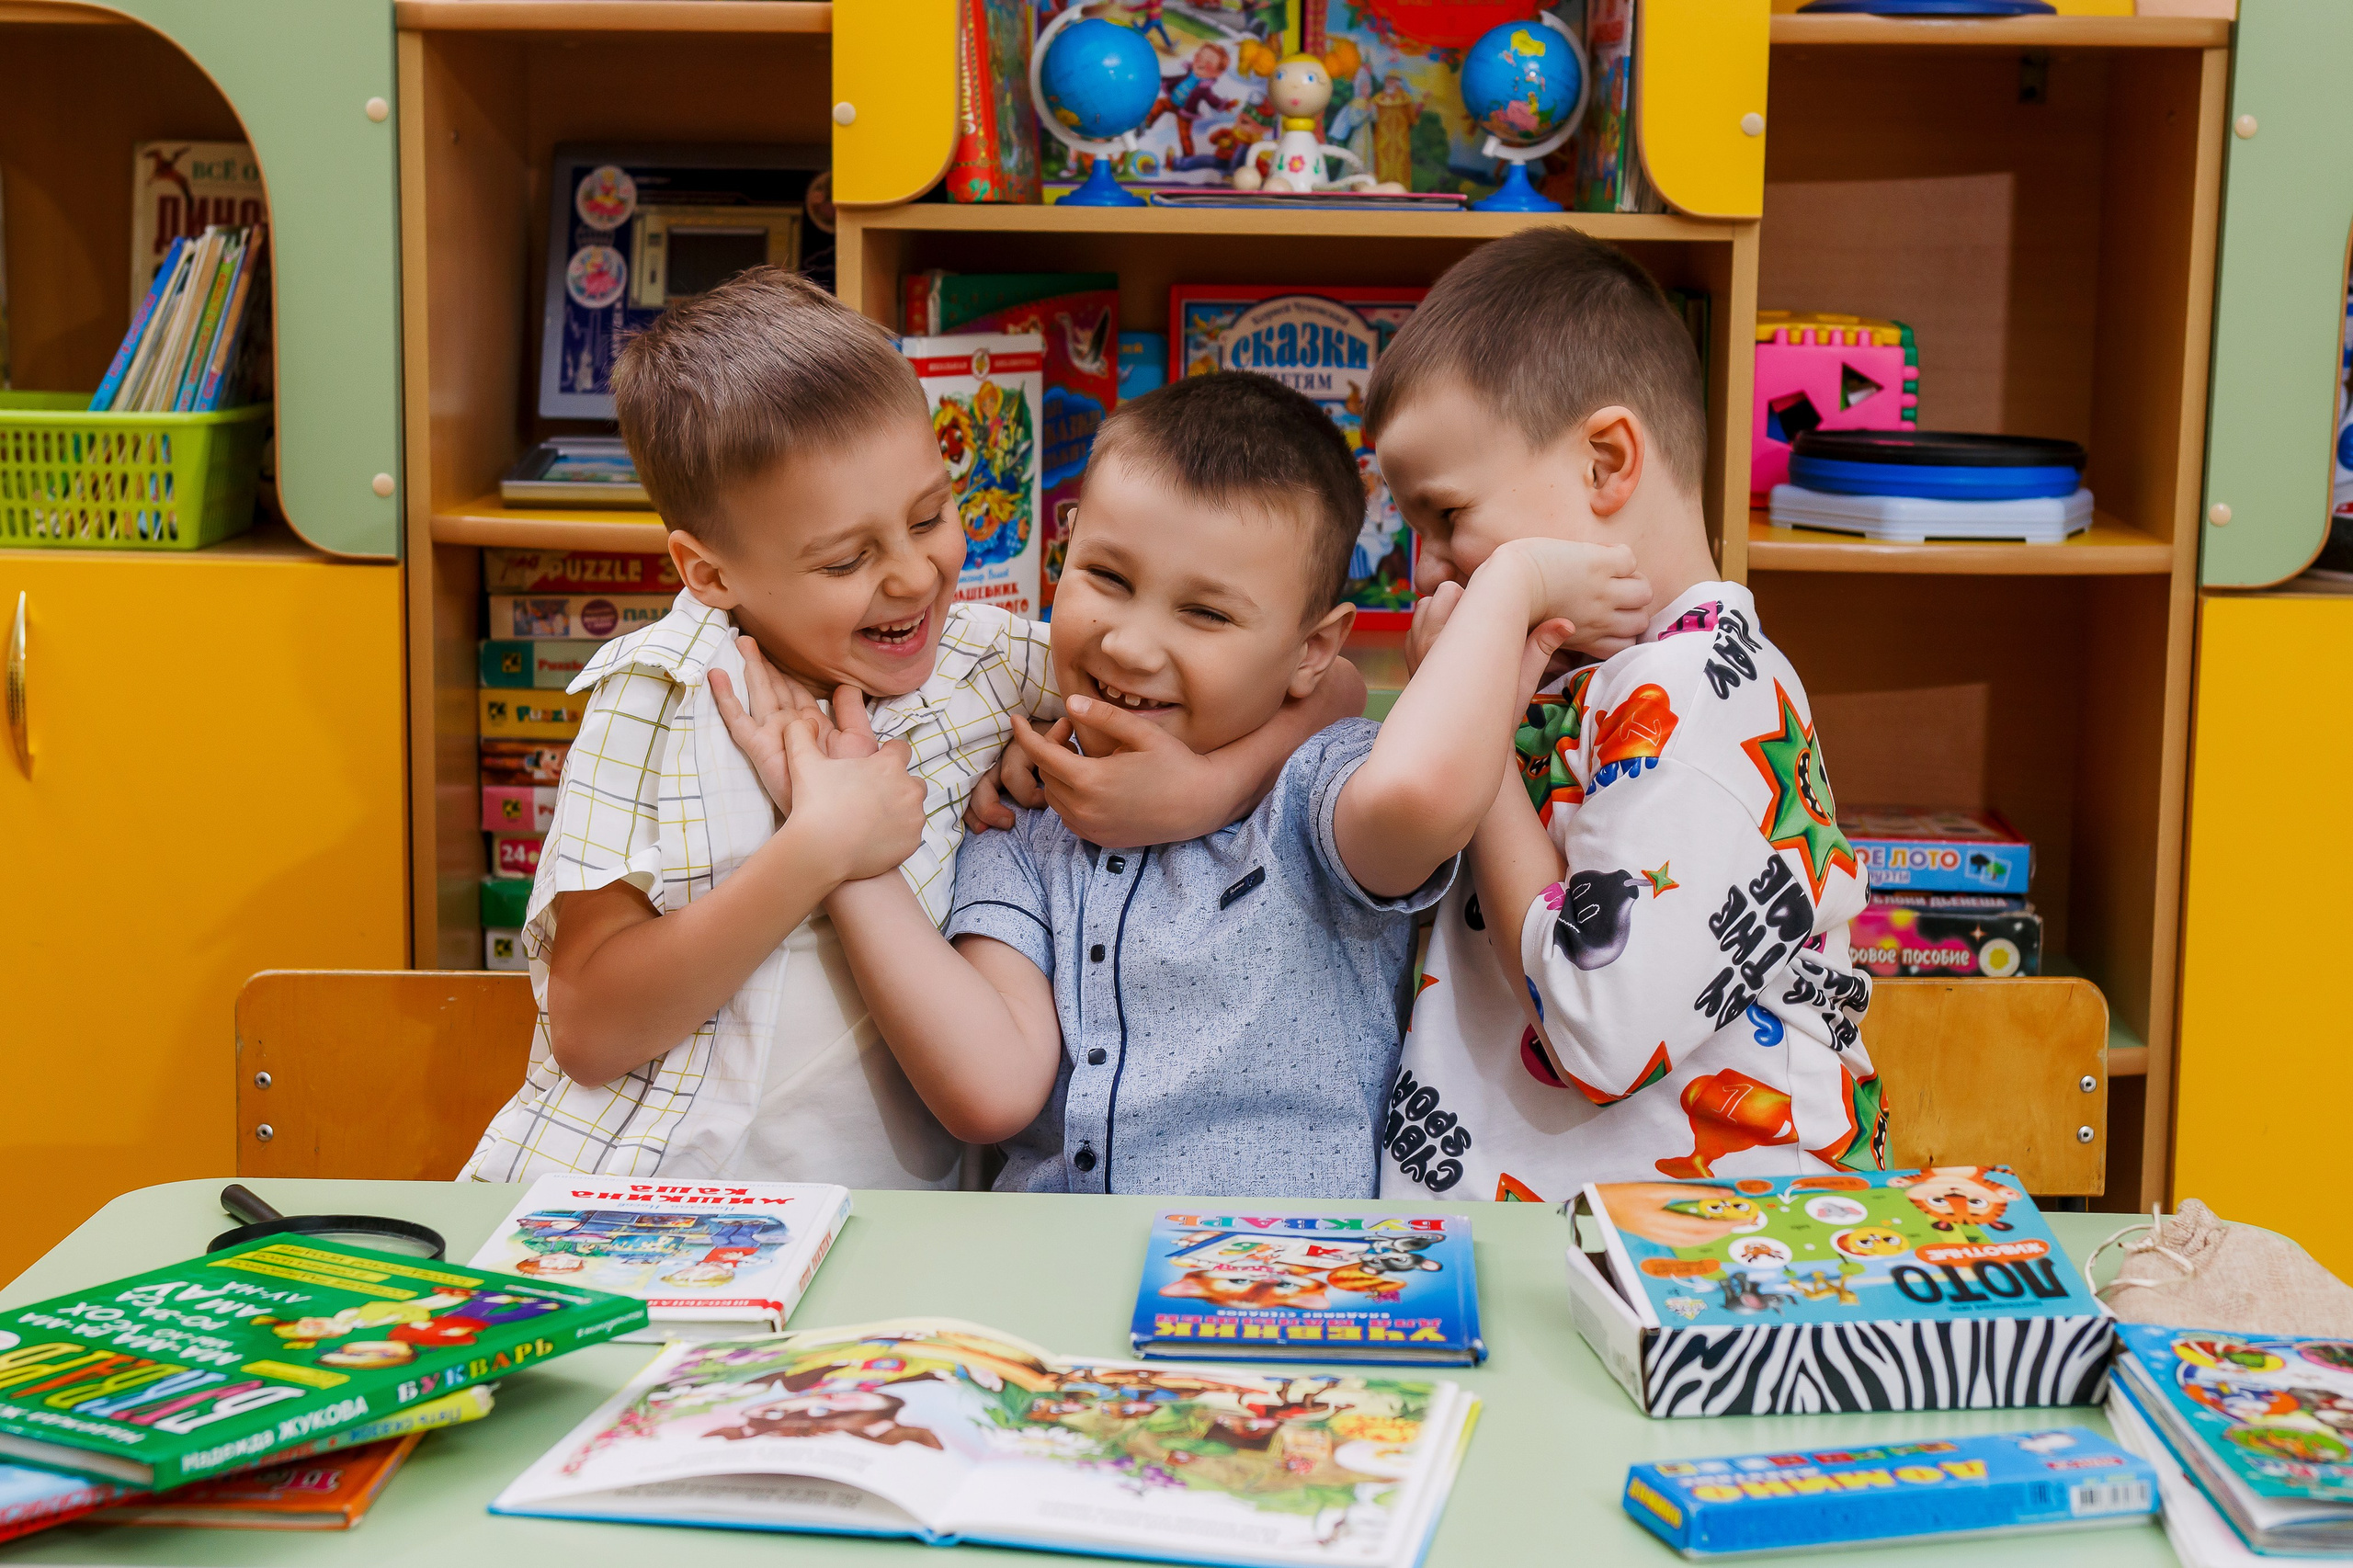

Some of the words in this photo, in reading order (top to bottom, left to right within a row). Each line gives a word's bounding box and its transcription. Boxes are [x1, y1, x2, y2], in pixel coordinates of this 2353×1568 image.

[1890, 847, 1960, 870] ЛОТО
[1392, 1065, 1472, 1157] SPOR
[1165, 1213, 1446, 1233] БУКВАРЬ
[1927, 1243, 2046, 1263] ЖИВОТНЫЕ
[1890, 1258, 2069, 1306] ЛОТО
[1154, 1322, 1446, 1342] УЧЕБНИК
[396, 1335, 555, 1403] БУКВАРЬ
[278, 1394, 369, 1439] ЖУКОВА
[1689, 1458, 1988, 1505] ДОМИНО
